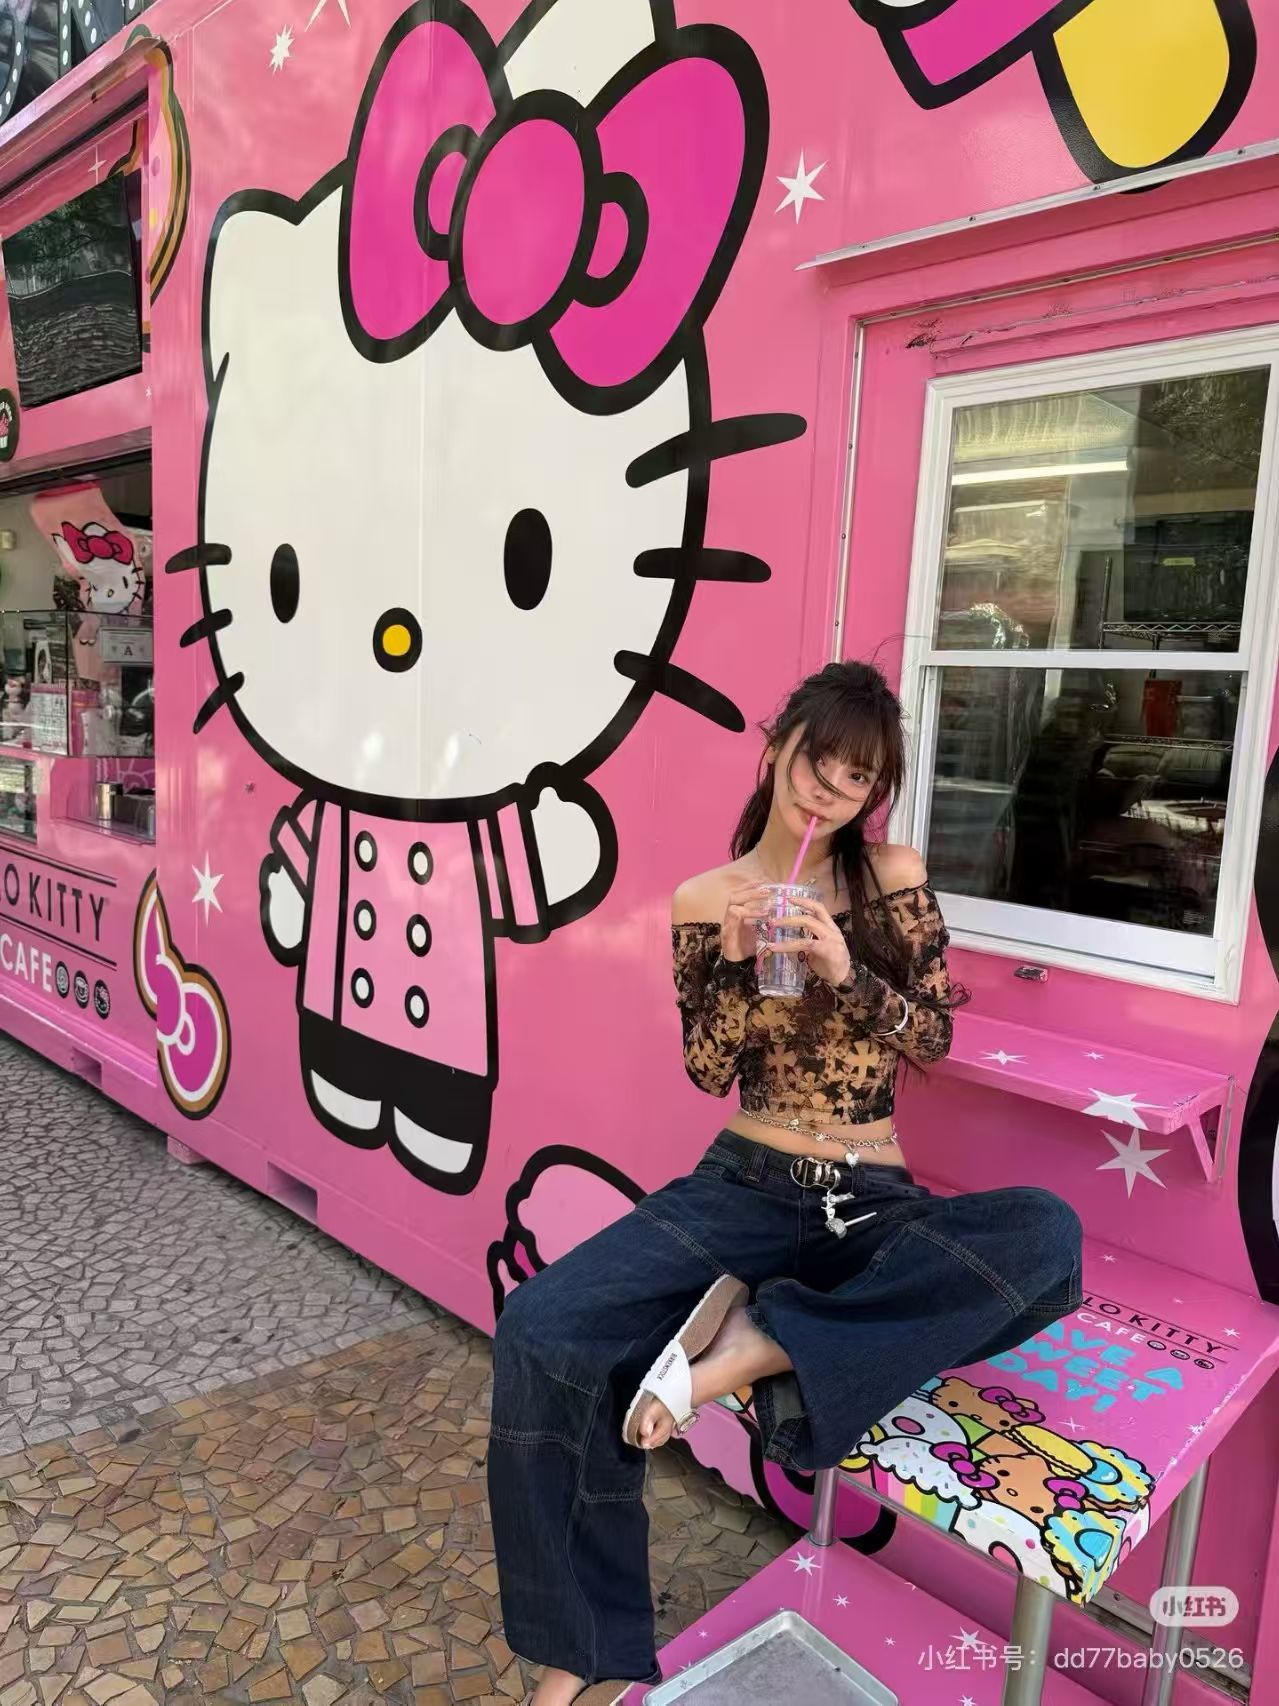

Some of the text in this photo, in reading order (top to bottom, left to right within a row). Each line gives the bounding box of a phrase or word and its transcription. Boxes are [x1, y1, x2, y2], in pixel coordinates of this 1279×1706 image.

[0, 863, 105, 942] O KITTY
[0, 933, 52, 993] CAFE
[1076, 1312, 1146, 1344] CAFE
[1129, 1314, 1222, 1354] KITTY
[1144, 1367, 1185, 1391] A
